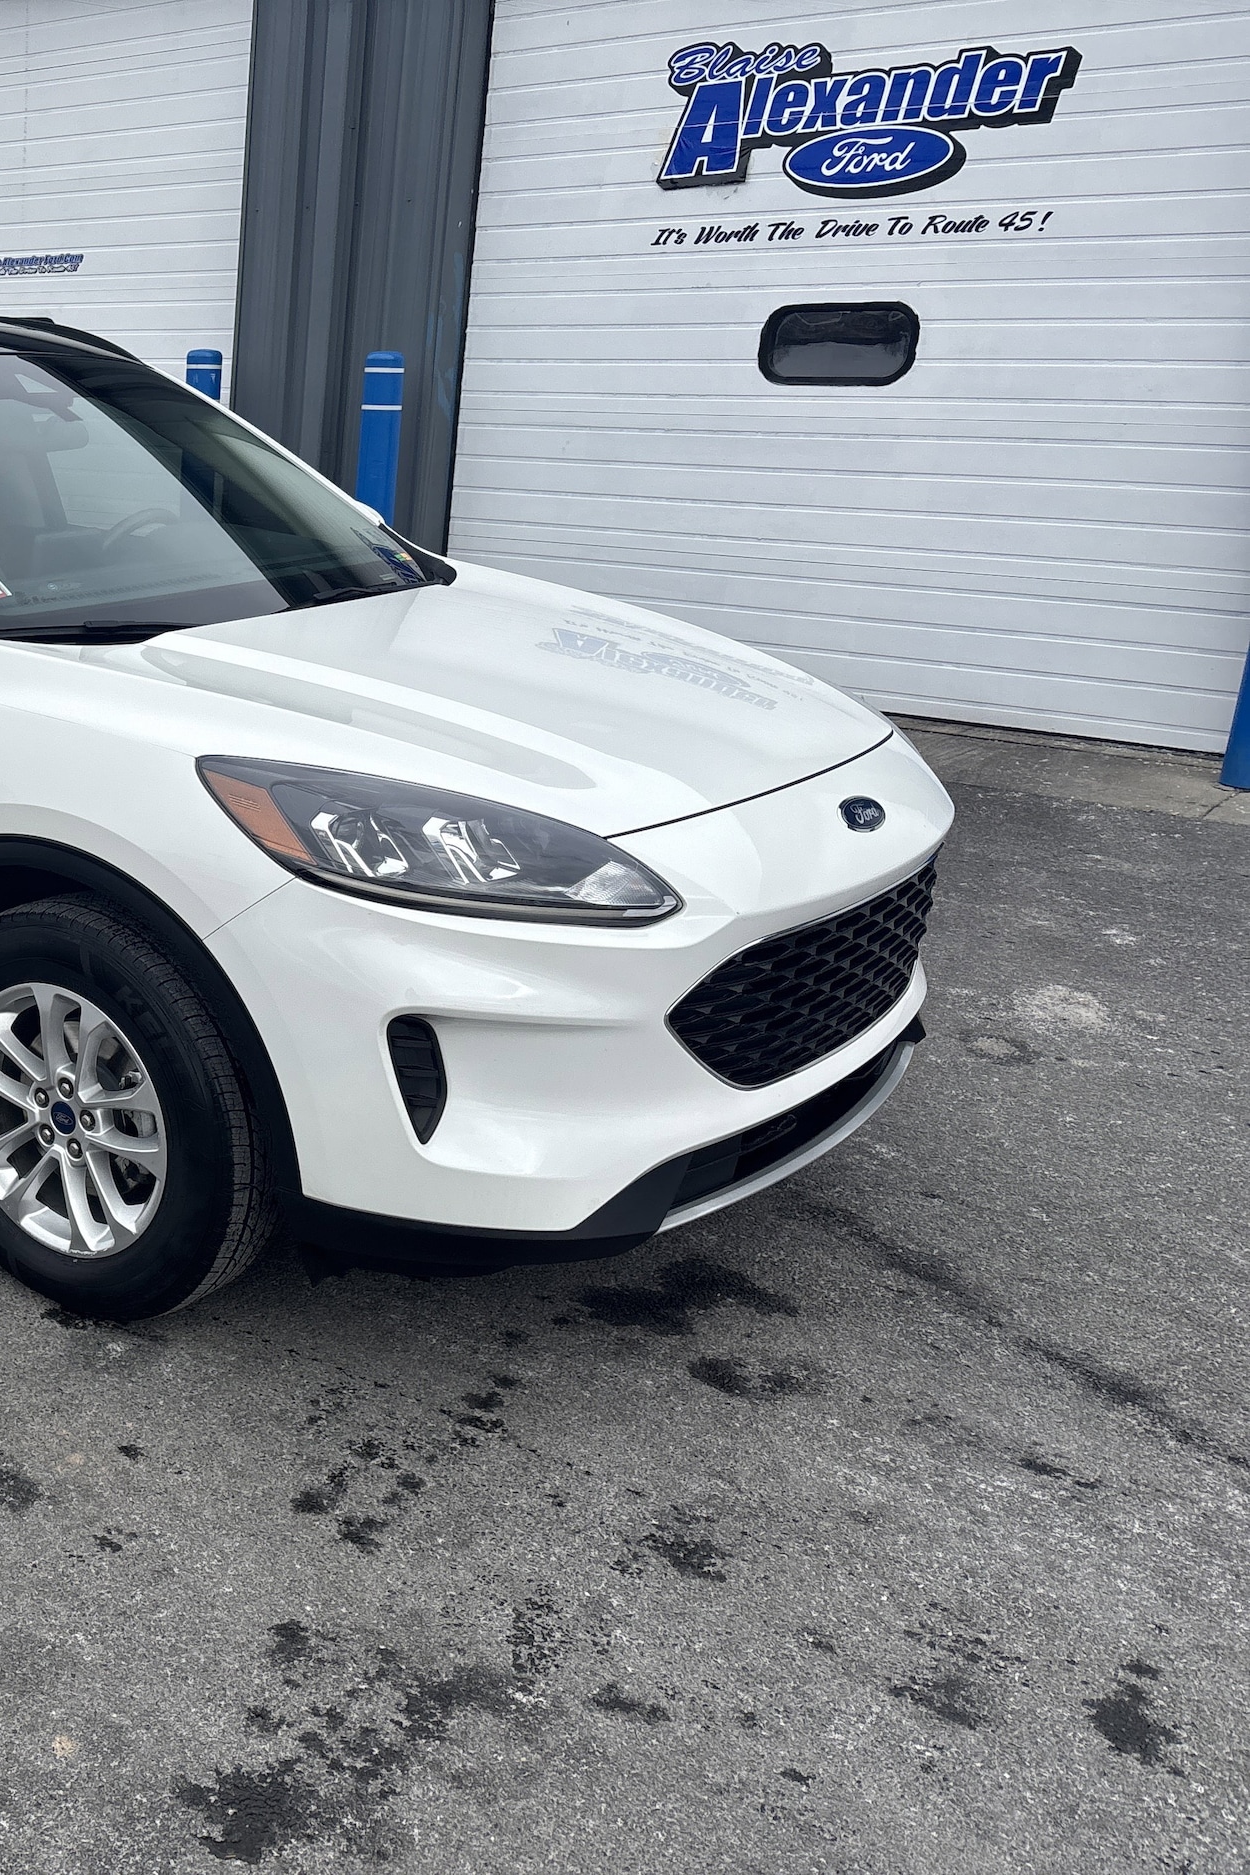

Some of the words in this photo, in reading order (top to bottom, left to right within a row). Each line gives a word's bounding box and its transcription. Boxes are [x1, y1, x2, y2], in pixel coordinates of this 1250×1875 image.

[671, 44, 822, 87] Blaise
[660, 49, 1068, 181] Alexander
[819, 136, 916, 177] Ford
[650, 227, 688, 246] It's
[693, 221, 759, 246] Worth
[767, 219, 805, 242] The
[814, 218, 880, 240] Drive
[887, 215, 914, 236] To
[920, 213, 991, 236] Route
[850, 802, 880, 824] Ford
